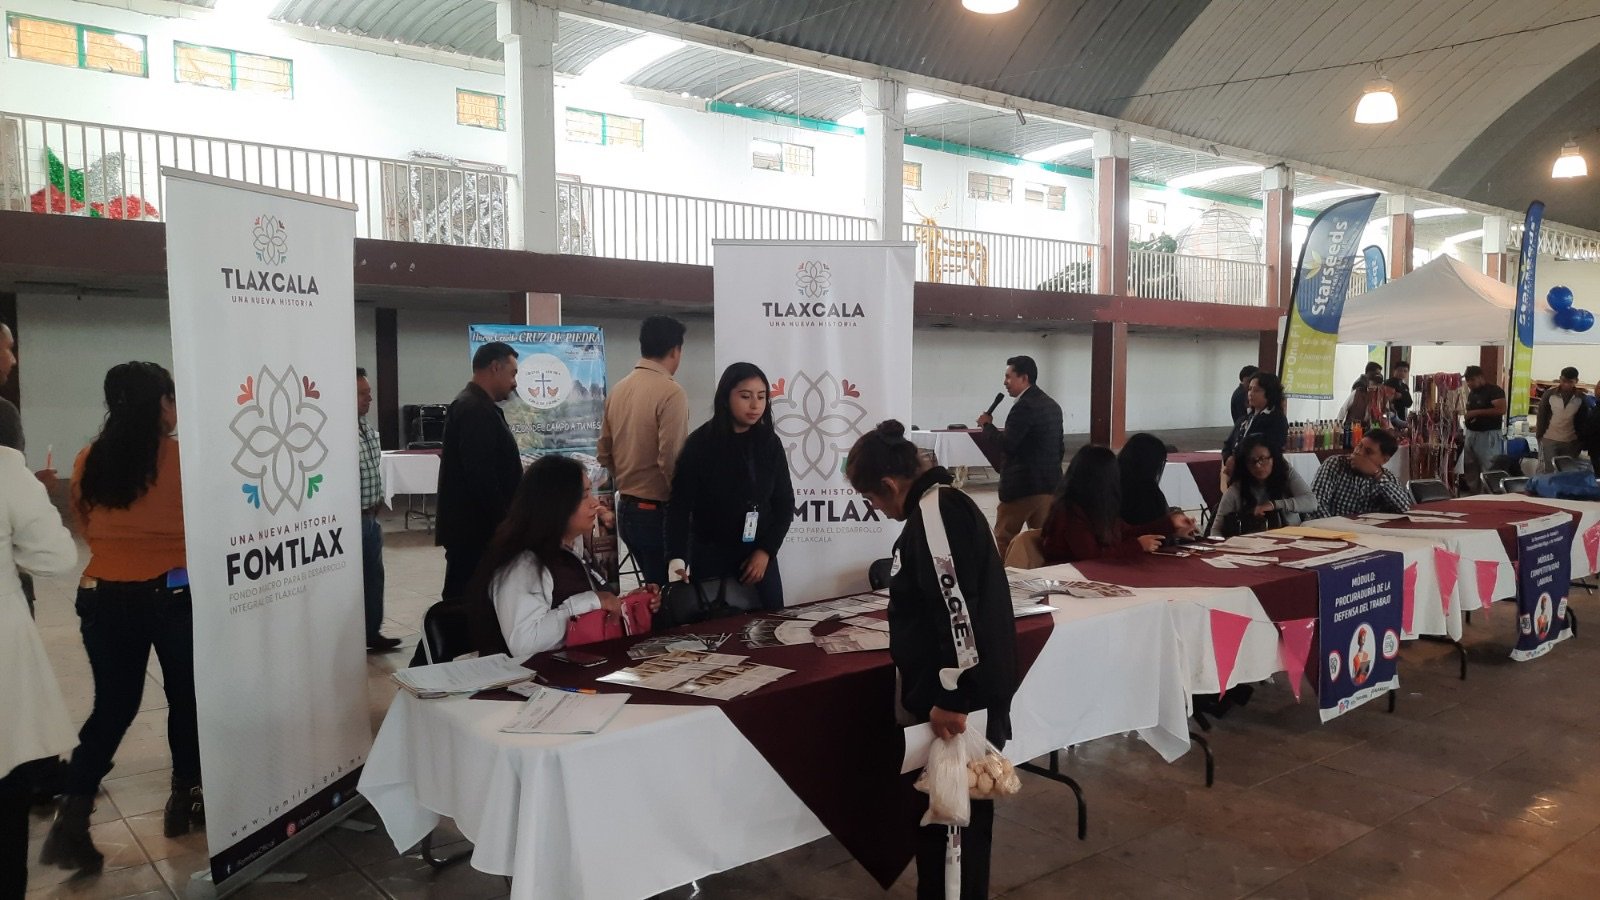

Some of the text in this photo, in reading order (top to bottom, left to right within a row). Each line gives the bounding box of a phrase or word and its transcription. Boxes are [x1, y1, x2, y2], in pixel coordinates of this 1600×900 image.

[1311, 220, 1349, 316] Starseeds
[221, 267, 319, 295] TLAXCALA
[231, 295, 313, 307] UNA NUEVA HISTORIA
[762, 302, 865, 318] TLAXCALA
[519, 332, 548, 343] CRUZ
[549, 332, 564, 343] DE
[565, 332, 601, 343] PIEDRA
[796, 488, 816, 496] EVA
[793, 500, 881, 522] MTLAX
[230, 514, 337, 547] UNA NUEVA HISTORIA
[835, 526, 883, 534] DESARROLLO
[226, 527, 344, 586] FOMTLAX
[1351, 572, 1376, 587] MÓDULO:
[229, 587, 258, 602] FONDO
[1335, 581, 1391, 607] PROCURADURÍA DE LA
[1333, 594, 1391, 624] DEFENSA DEL TRABAJO
